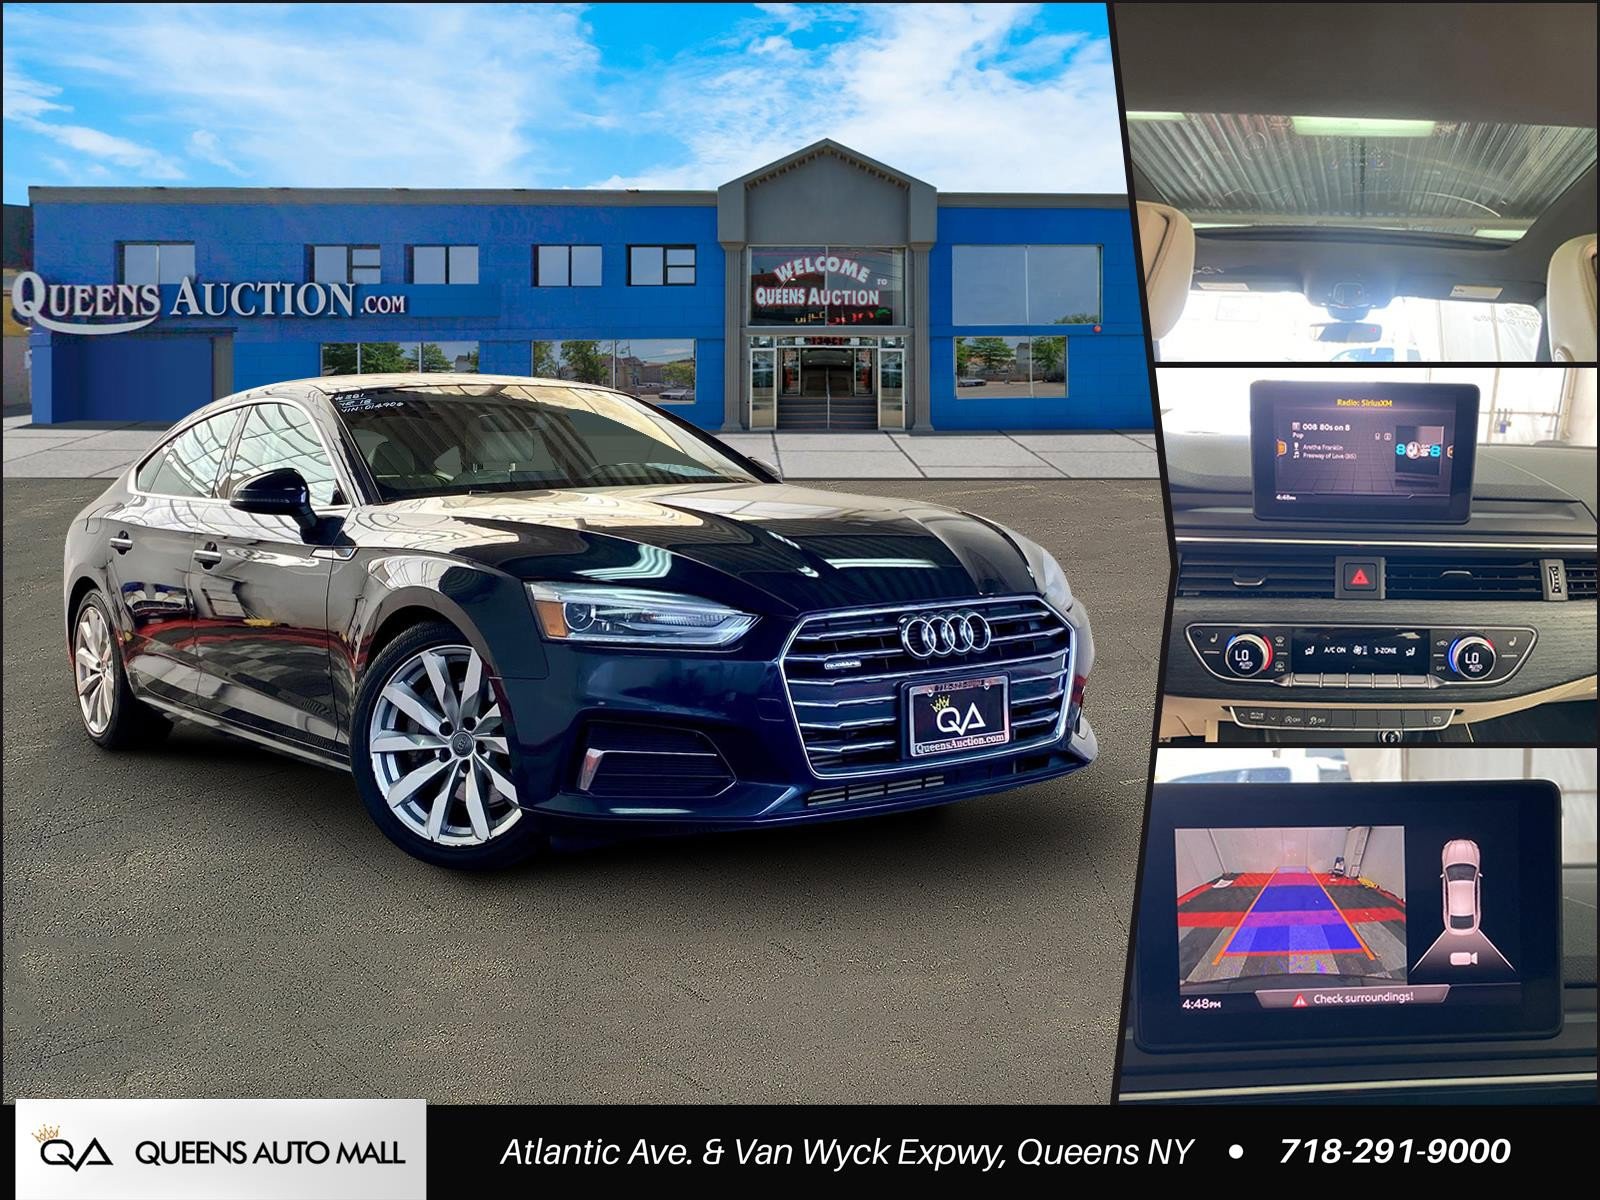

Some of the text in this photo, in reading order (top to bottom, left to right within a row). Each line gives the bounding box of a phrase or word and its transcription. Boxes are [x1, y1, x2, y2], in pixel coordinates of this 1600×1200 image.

[774, 255, 871, 283] WELCOME
[755, 285, 880, 308] QUEENS AUCTION
[12, 271, 161, 335] QUEENS
[1361, 398, 1393, 407] SiriusXM
[1344, 424, 1351, 432] 8
[1292, 432, 1304, 440] Pop
[1235, 650, 1249, 661] LO
[1324, 646, 1347, 654] A/C ON
[1465, 652, 1480, 664] LO
[916, 733, 1006, 754] QueensAuction.com
[1314, 991, 1414, 1005] Check surroundings!
[1183, 999, 1222, 1010] 4:48PM
